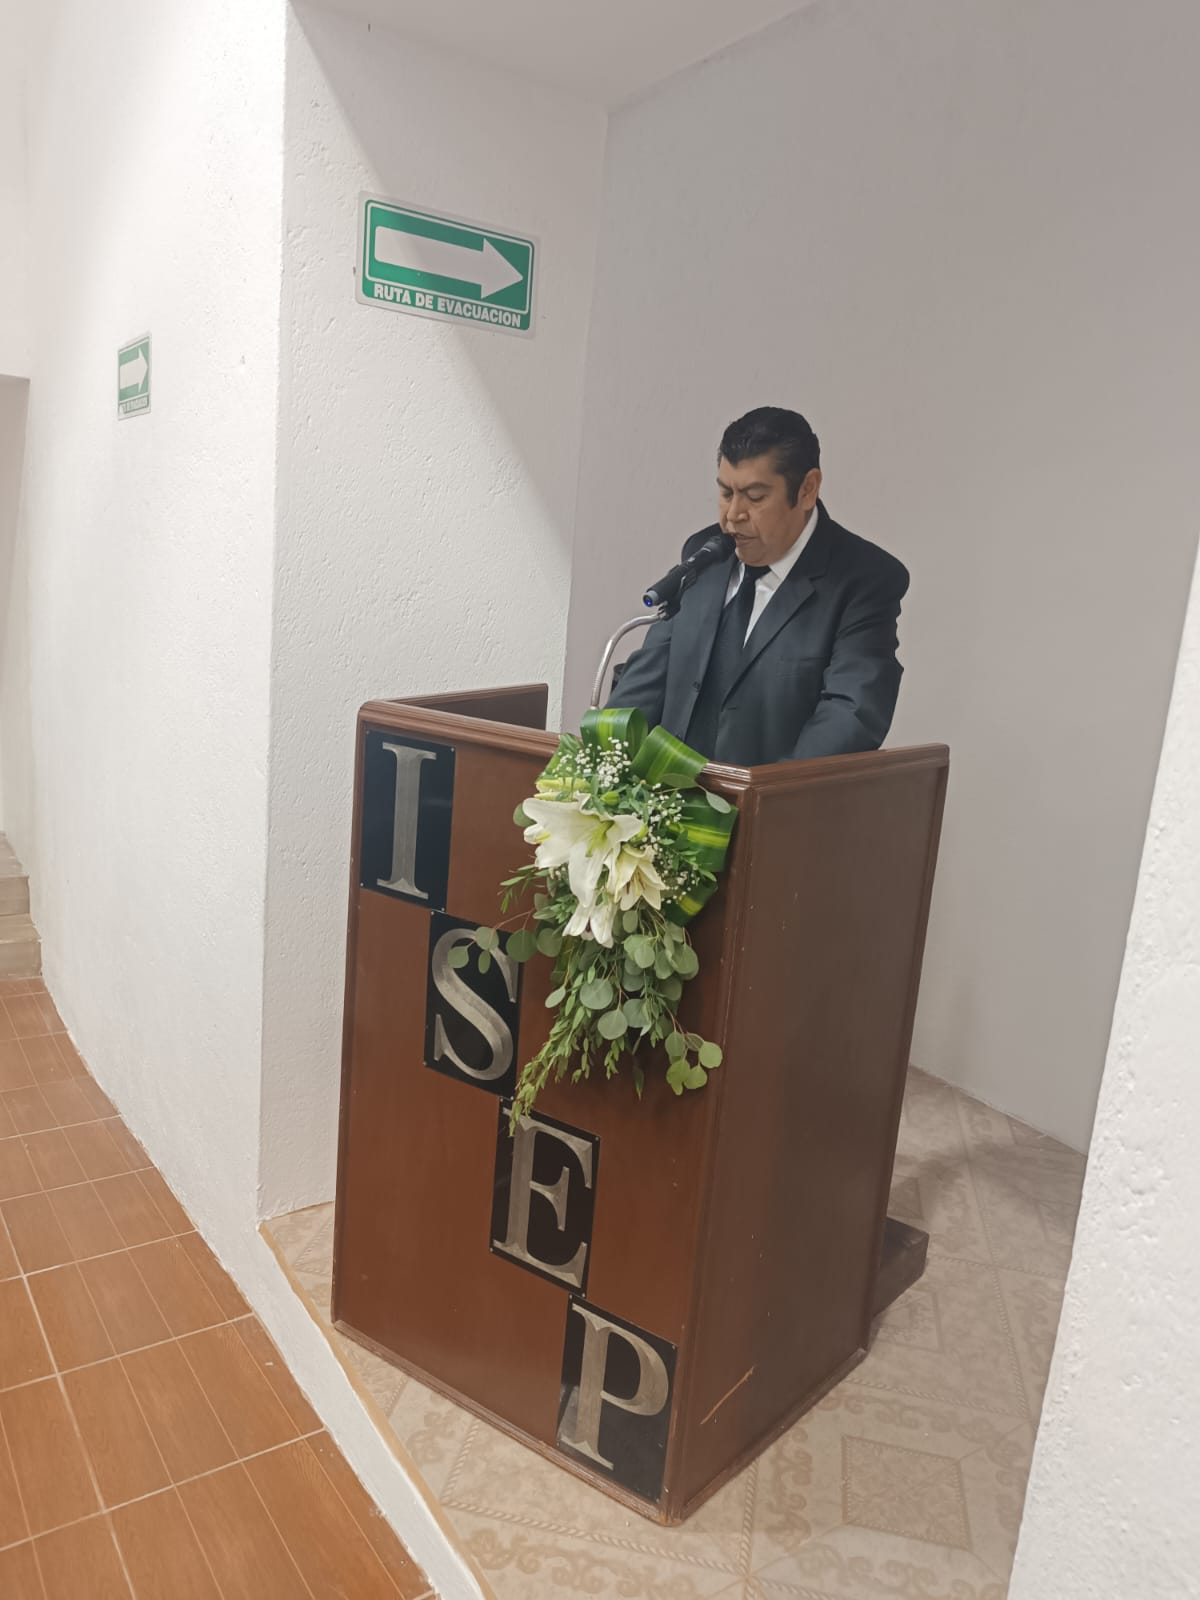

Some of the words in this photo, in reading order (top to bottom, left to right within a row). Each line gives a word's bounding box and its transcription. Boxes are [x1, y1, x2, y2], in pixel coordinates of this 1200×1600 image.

[373, 283, 411, 305] RUTA
[415, 292, 434, 310] DE
[437, 298, 521, 328] EVACUACION
